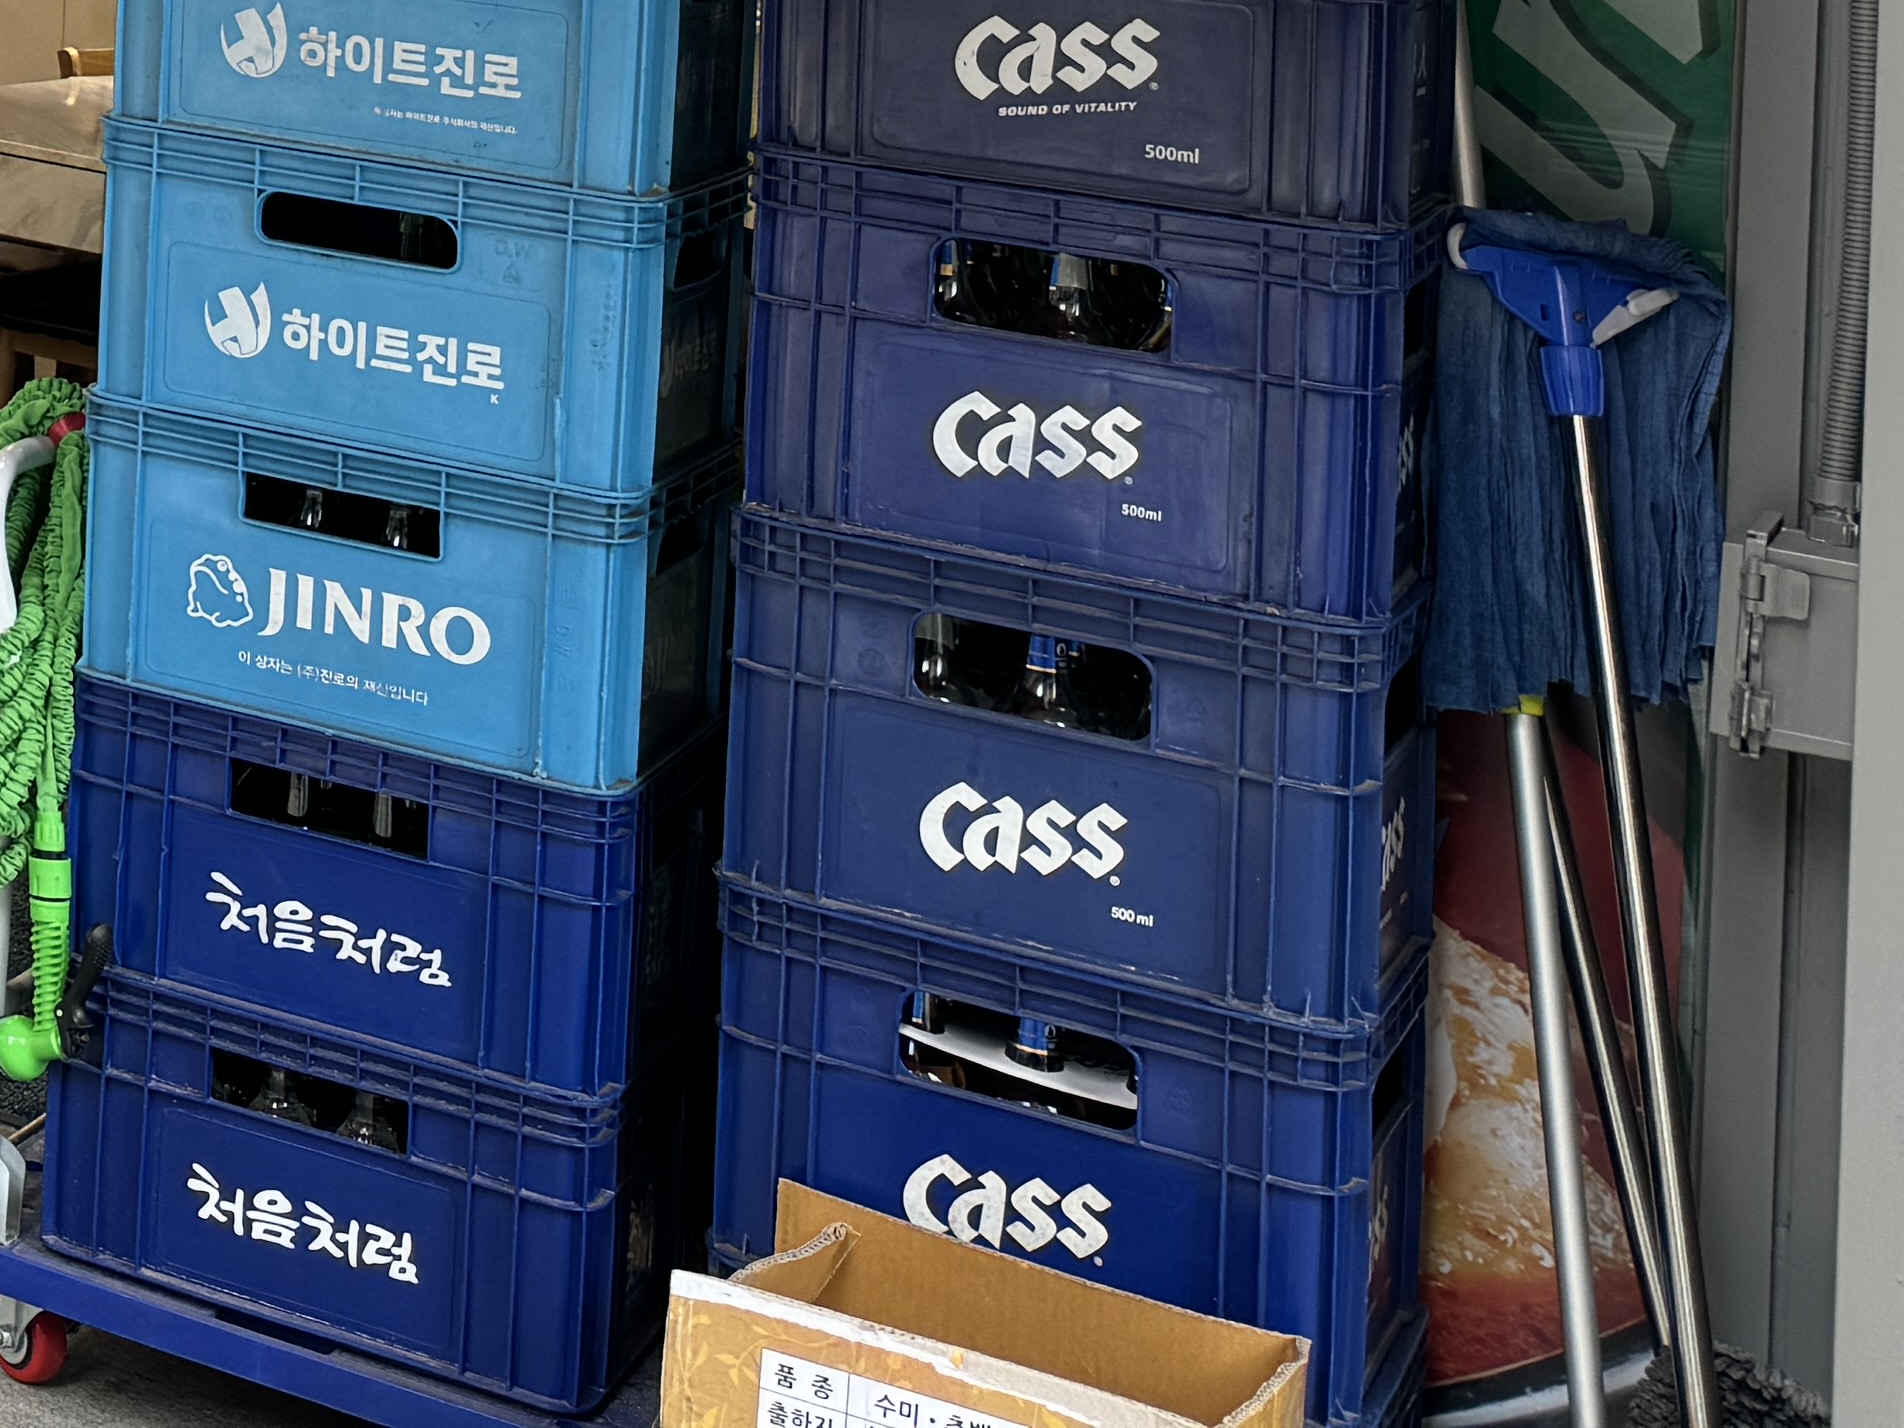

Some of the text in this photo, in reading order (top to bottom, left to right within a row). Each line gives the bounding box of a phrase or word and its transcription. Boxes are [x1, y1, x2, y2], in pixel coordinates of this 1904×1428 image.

[298, 25, 522, 100] 하이트진로
[954, 14, 1161, 101] Cass
[997, 100, 1138, 118] SOUND OF VITALITY
[1144, 144, 1200, 165] 500ml
[281, 308, 505, 391] 하이트진로
[932, 391, 1142, 480] Cass
[1120, 503, 1162, 523] 500ml
[258, 567, 491, 665] JINRO
[238, 650, 428, 706] 이 상자는 (주)진로의 재산입니다
[920, 781, 1128, 881] Cass
[205, 871, 452, 988] 처음처럼
[187, 1164, 420, 1284] 처음처럼
[902, 1153, 1112, 1259] Cass
